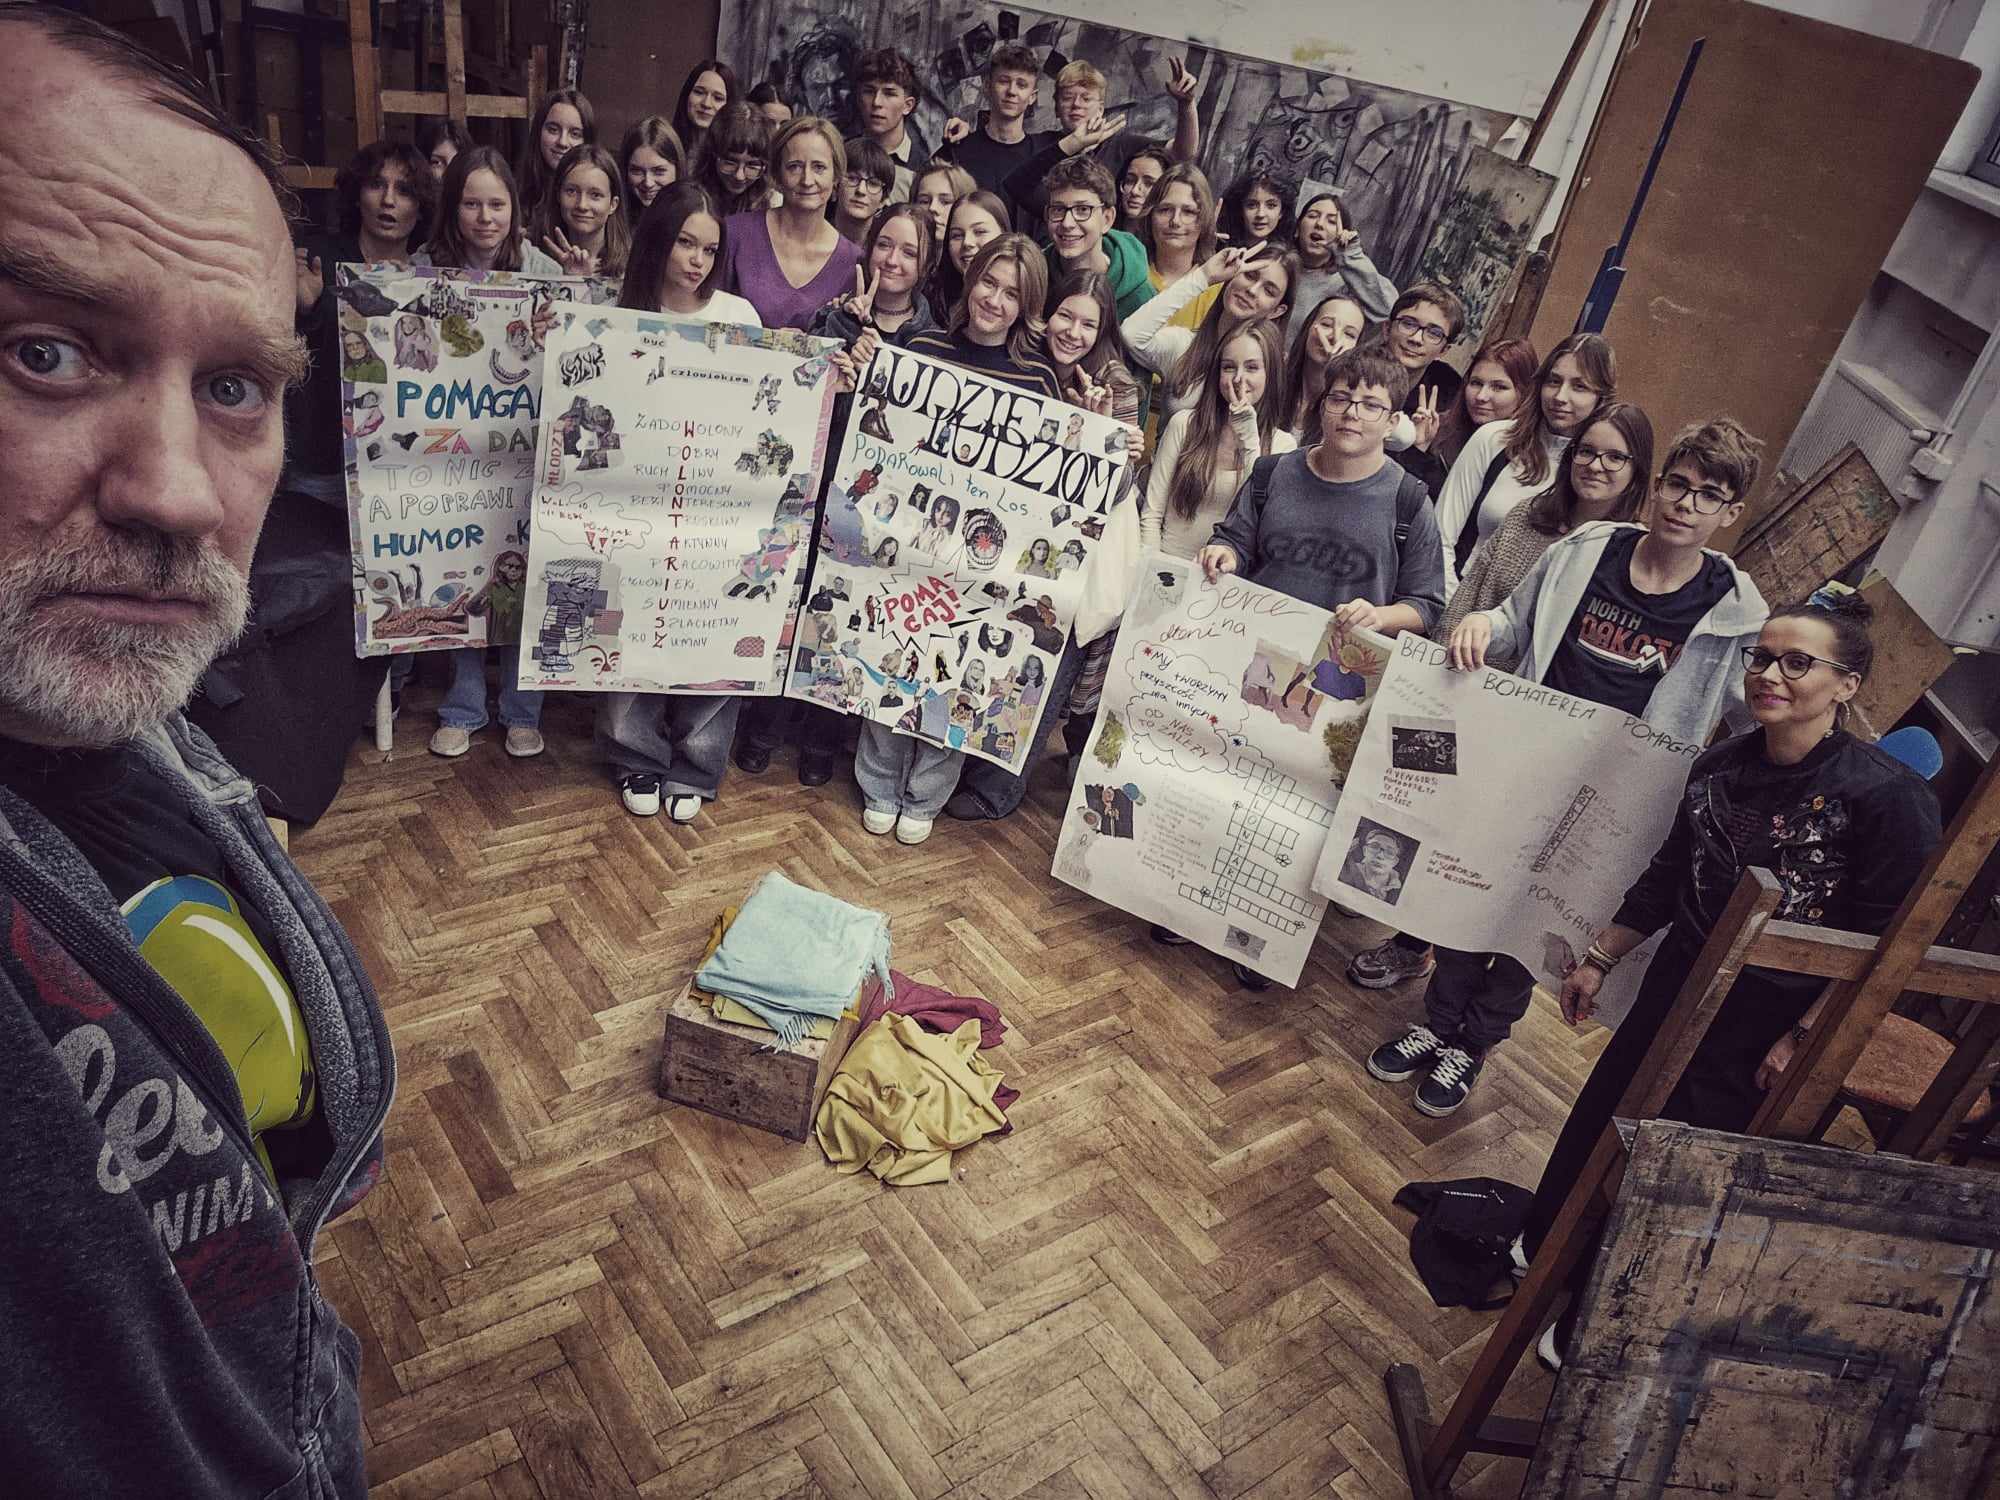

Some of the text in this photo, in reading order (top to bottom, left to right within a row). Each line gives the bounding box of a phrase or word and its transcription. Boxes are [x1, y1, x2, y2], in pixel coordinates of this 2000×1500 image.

[397, 378, 542, 420] POMAGA
[424, 428, 473, 455] ZA
[369, 496, 392, 524] A
[399, 486, 514, 521] POPRAWI
[373, 523, 486, 558] HUMOR
[1587, 597, 1643, 630] NORTH
[1527, 884, 1595, 938] POMAGAN
